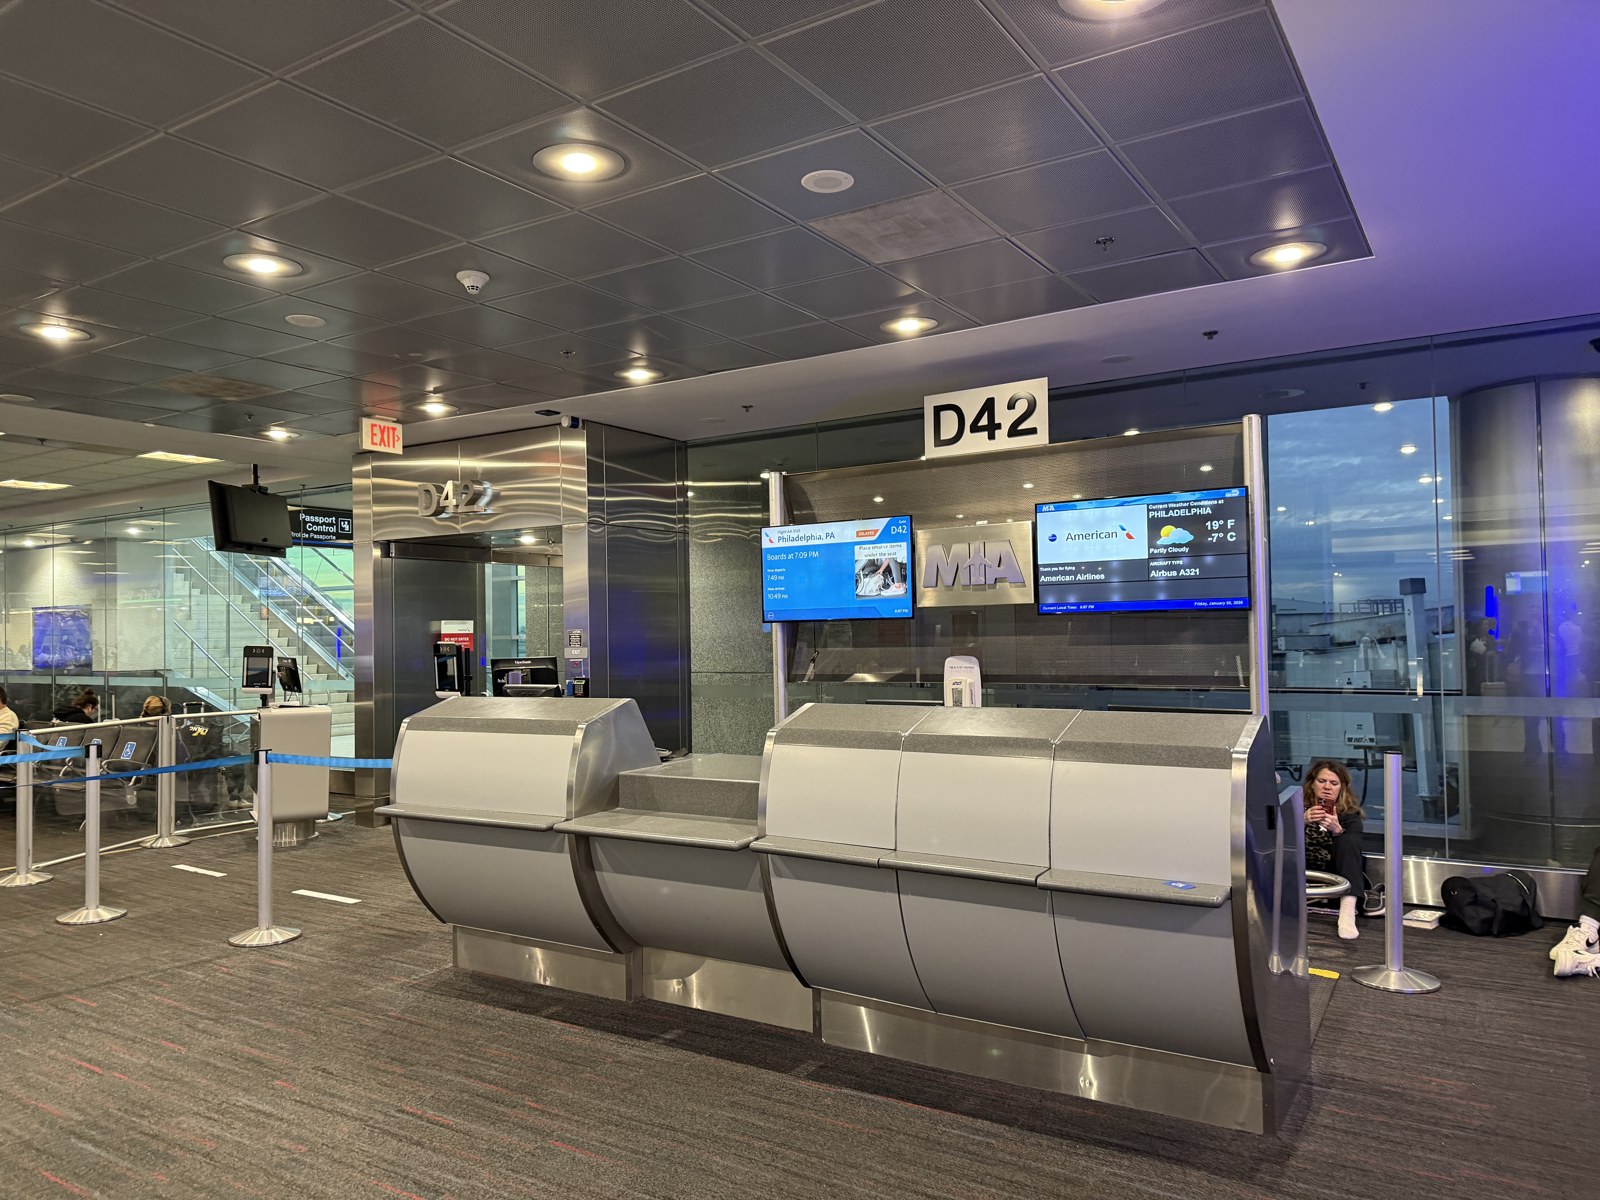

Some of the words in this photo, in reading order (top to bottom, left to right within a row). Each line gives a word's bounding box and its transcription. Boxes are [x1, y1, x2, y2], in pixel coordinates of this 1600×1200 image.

[933, 391, 1037, 447] D42
[370, 423, 397, 448] EXIT
[418, 480, 485, 517] D42
[1149, 507, 1212, 518] PHILADELPHIA
[300, 513, 336, 524] Passport
[306, 523, 336, 532] Control
[891, 526, 907, 534] D42
[1206, 520, 1224, 530] 19°
[1227, 520, 1235, 529] F
[777, 532, 824, 543] Philadelphia,
[1066, 530, 1118, 541] American
[1208, 532, 1224, 542] -7°
[1227, 532, 1236, 541] C
[767, 551, 786, 560] Boards
[922, 539, 1027, 588] MIA
